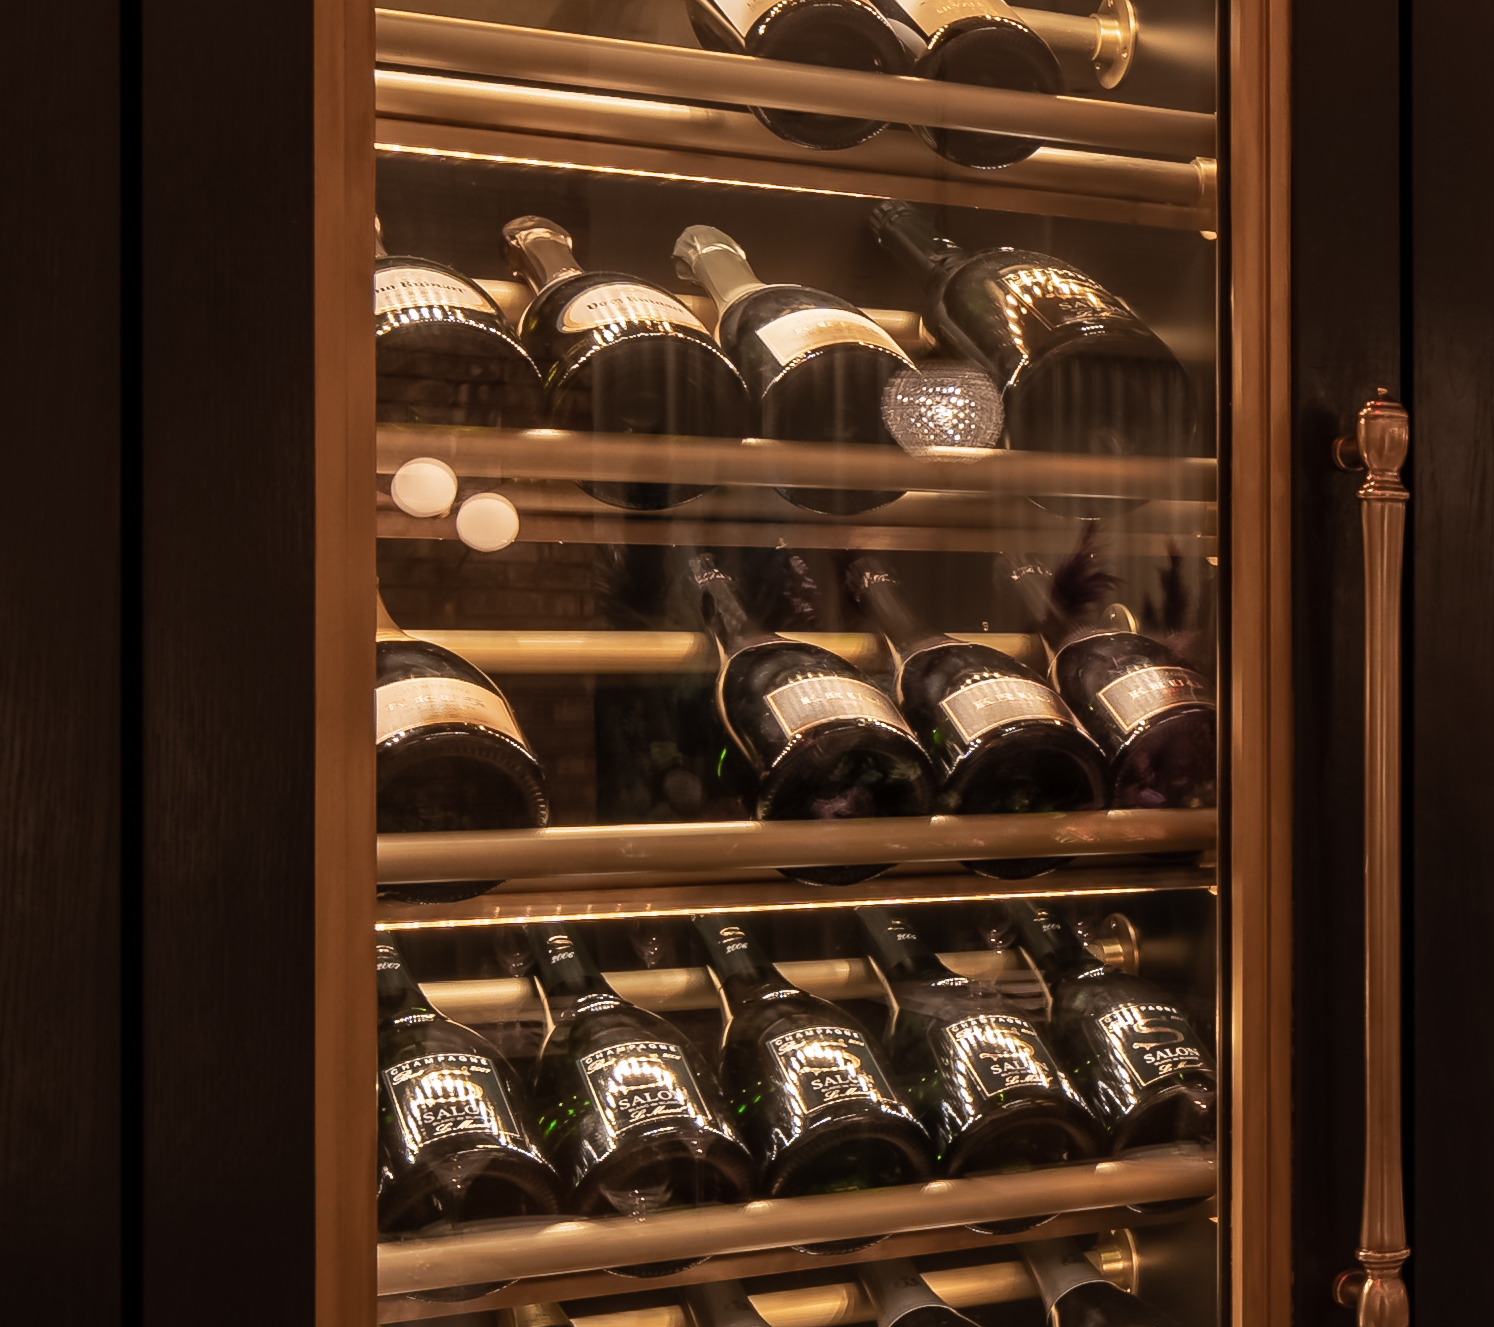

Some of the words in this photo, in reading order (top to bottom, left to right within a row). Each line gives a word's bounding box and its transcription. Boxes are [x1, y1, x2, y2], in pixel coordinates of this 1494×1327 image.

[774, 1028, 859, 1046] CHAMPAGNE
[585, 1043, 678, 1065] CHAMPAGNE
[1144, 1046, 1201, 1065] SALON
[390, 1055, 489, 1076] CHAMPAGNE
